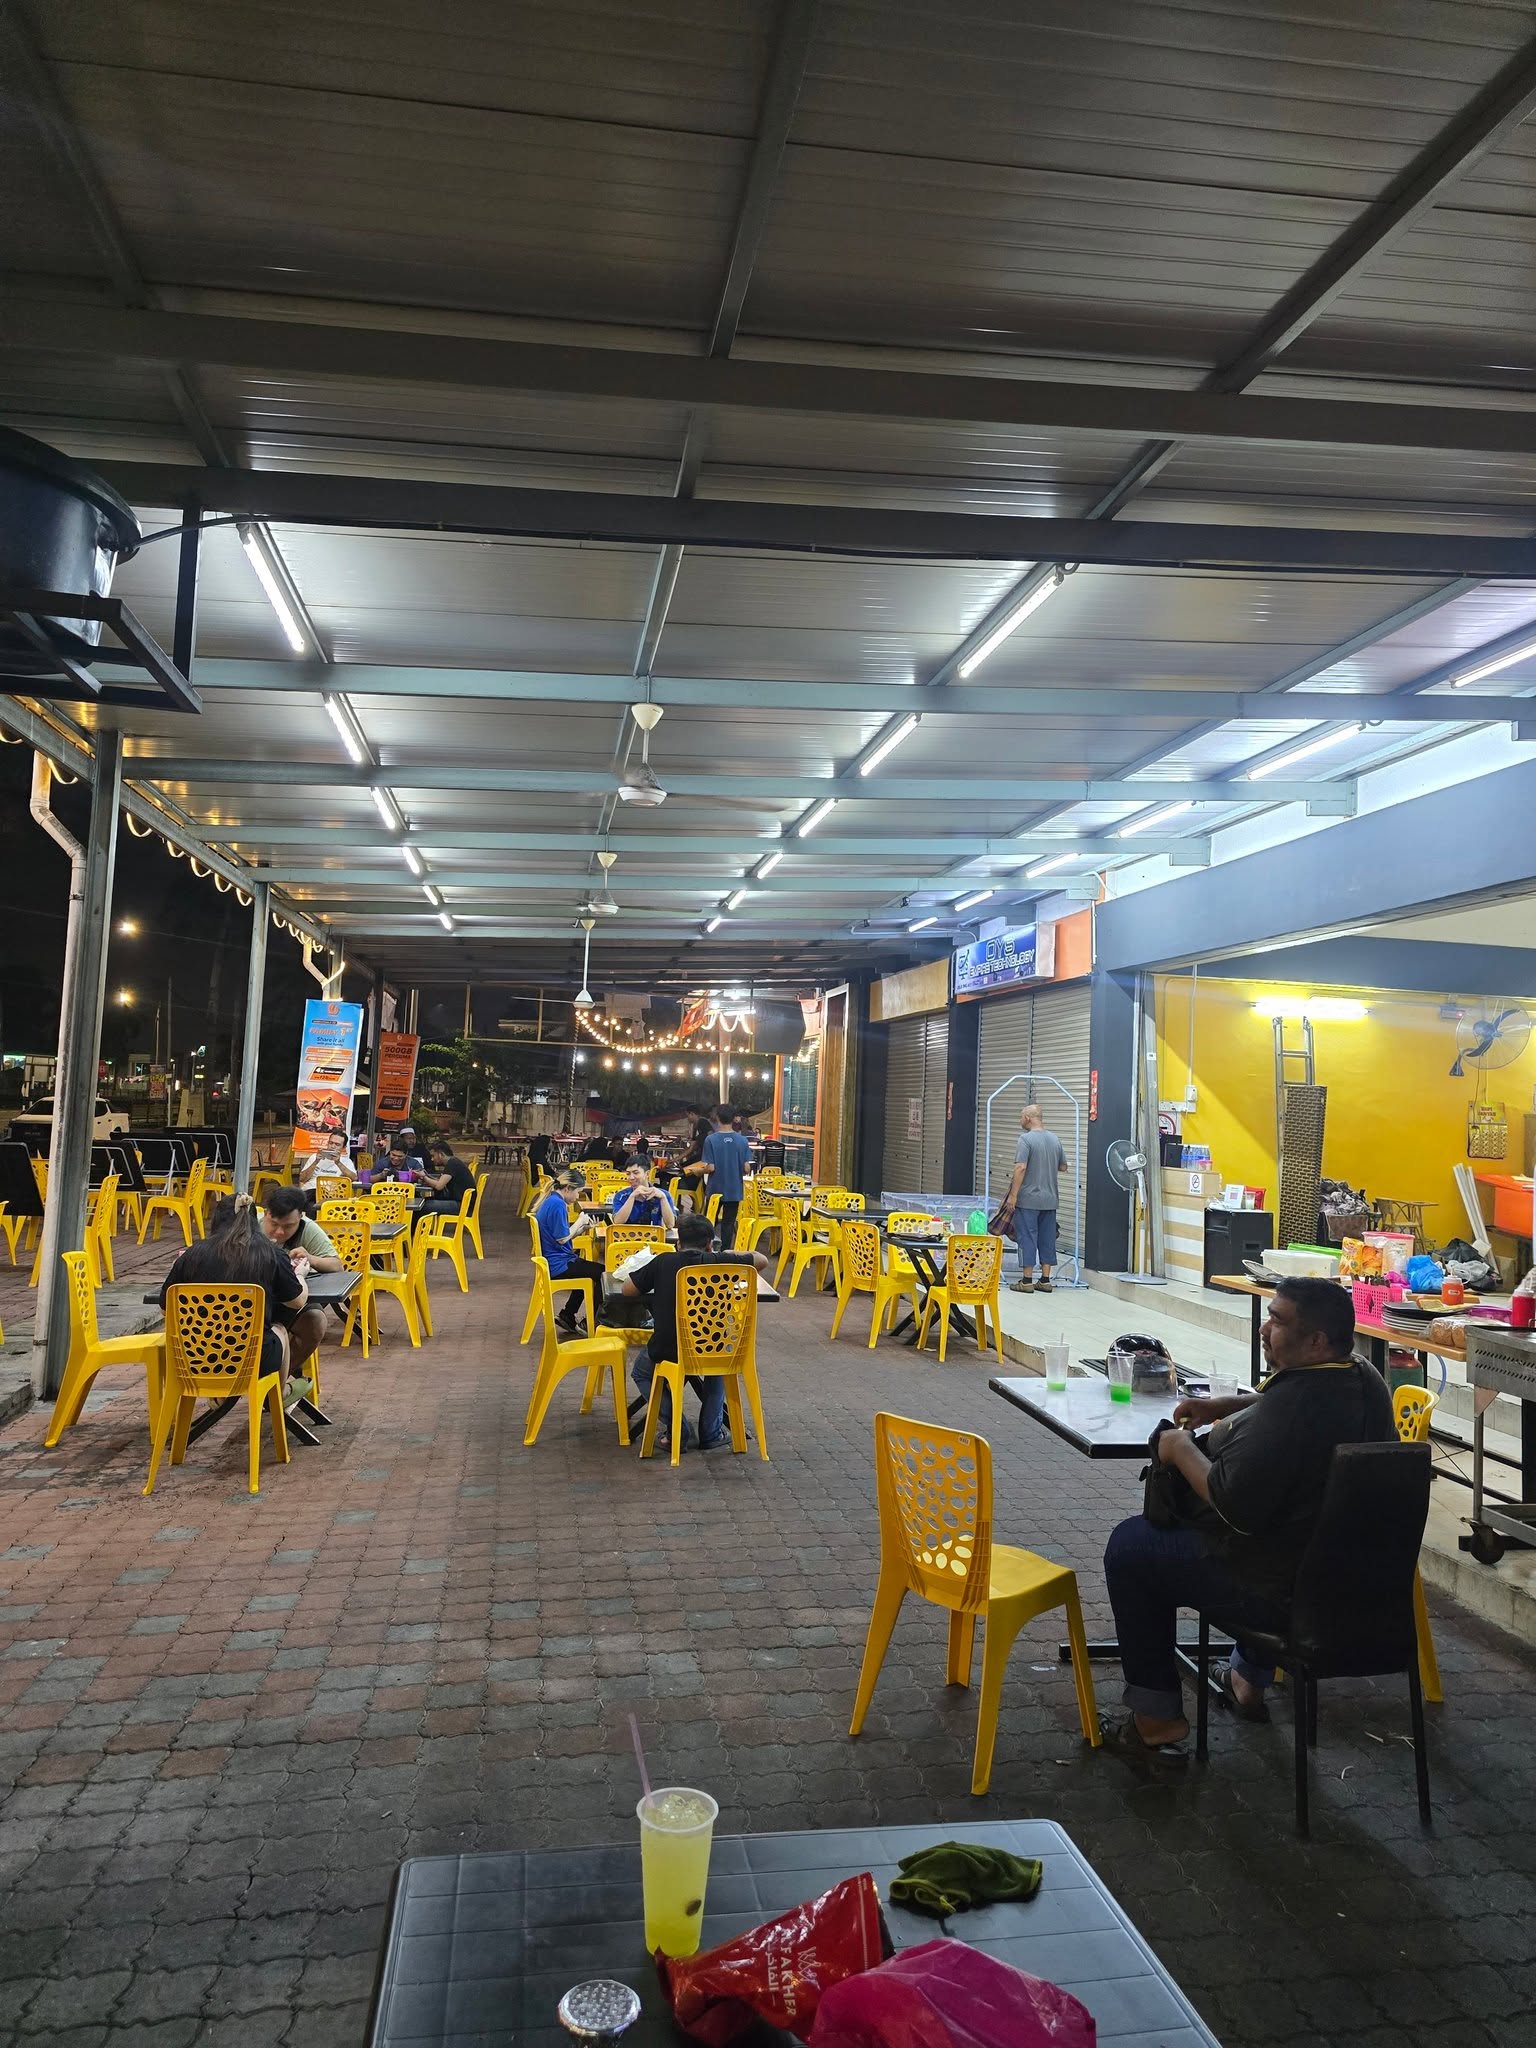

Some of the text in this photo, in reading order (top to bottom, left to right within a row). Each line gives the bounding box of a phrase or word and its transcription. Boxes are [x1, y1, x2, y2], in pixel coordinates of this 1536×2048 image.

[990, 949, 1035, 973] TECHNOLOGY
[384, 1046, 412, 1055] 500GB
[766, 1951, 779, 1993] الفاخر
[780, 1946, 797, 2016] FAKHER
